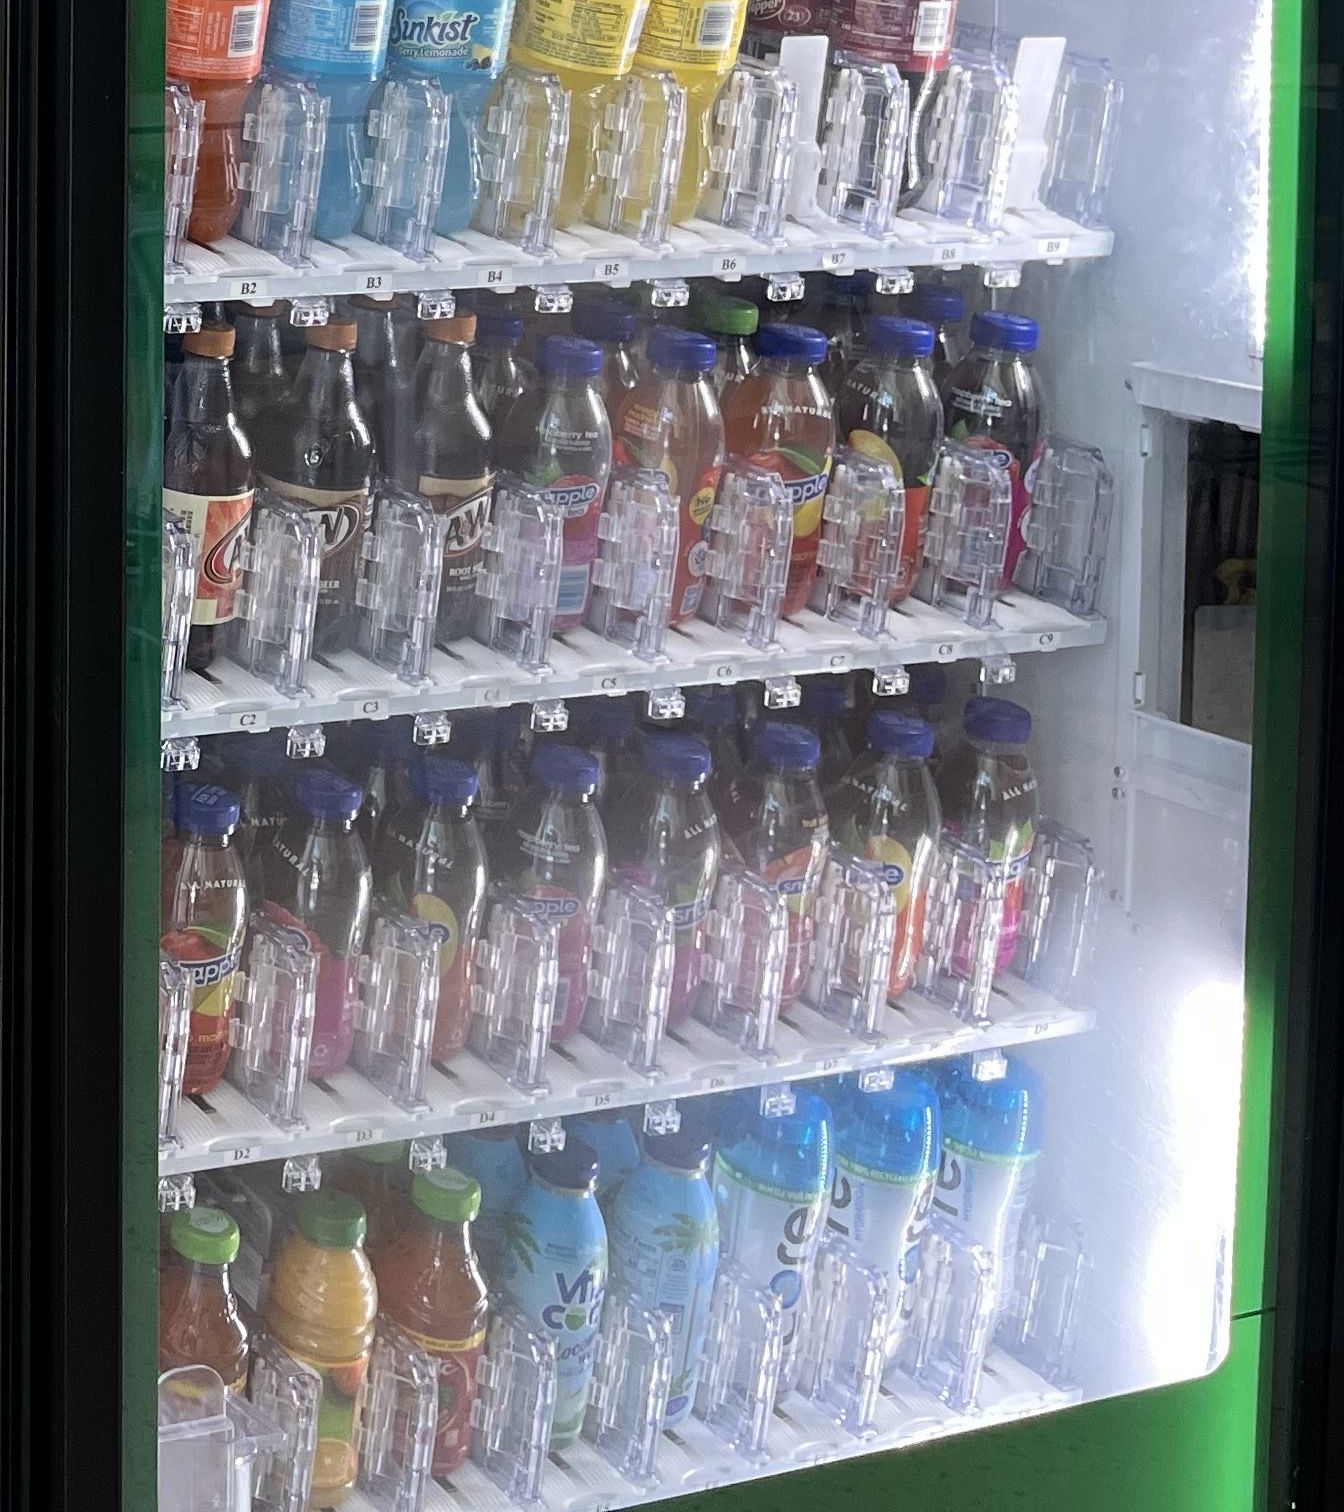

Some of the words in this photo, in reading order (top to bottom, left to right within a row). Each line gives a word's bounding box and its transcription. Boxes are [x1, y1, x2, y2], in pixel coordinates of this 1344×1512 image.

[787, 12, 801, 22] 23
[391, 7, 479, 46] Sunkist
[399, 47, 418, 58] Berry
[419, 46, 470, 58] Lemonade
[941, 247, 957, 261] B8
[1046, 241, 1061, 254] B9
[721, 258, 737, 271] B6
[831, 253, 846, 265] B7
[487, 270, 503, 283] B4
[603, 263, 620, 277] B5
[240, 282, 258, 296] B2
[366, 276, 383, 289] B3
[788, 405, 832, 419] NATURAL
[450, 500, 487, 546] A&W
[449, 568, 470, 577] ROOT
[1039, 632, 1054, 646] C9
[938, 643, 953, 656] C8
[829, 654, 846, 668] C7
[716, 665, 732, 678] C6
[600, 676, 617, 690] C5
[362, 701, 379, 714] C3
[239, 714, 257, 727] C2
[1003, 786, 1022, 800] ALL
[685, 826, 703, 839] ALL
[204, 879, 246, 890] NATURAL
[594, 1094, 611, 1107] D5
[479, 1111, 495, 1124] D4
[356, 1130, 373, 1143] D3
[233, 1148, 251, 1161] D2
